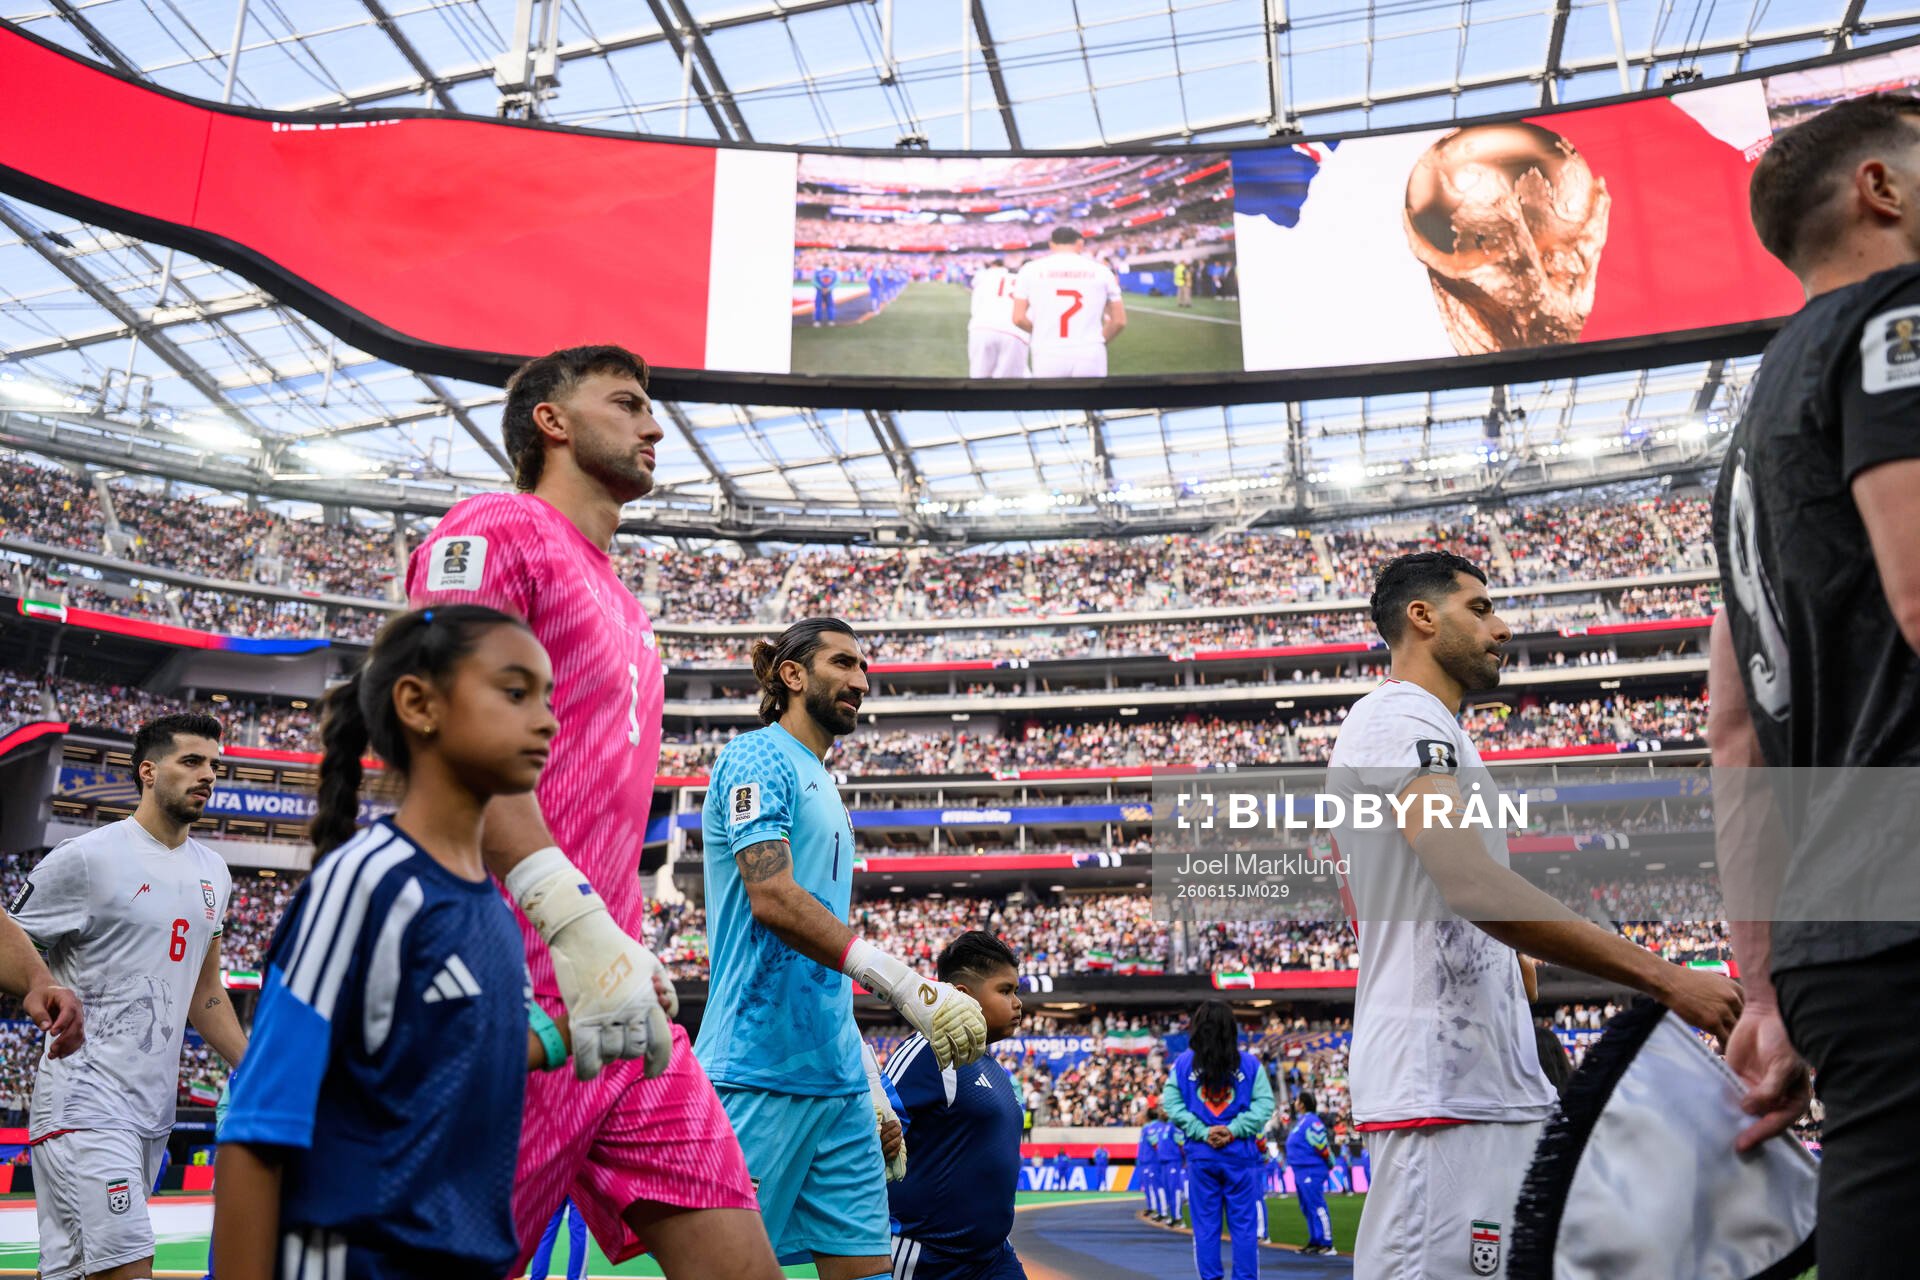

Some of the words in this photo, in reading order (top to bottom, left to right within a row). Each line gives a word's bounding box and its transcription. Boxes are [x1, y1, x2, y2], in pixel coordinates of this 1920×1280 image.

[1056, 290, 1083, 338] 7
[628, 663, 640, 747] 1
[832, 831, 839, 881] 1
[169, 918, 190, 962] 6
